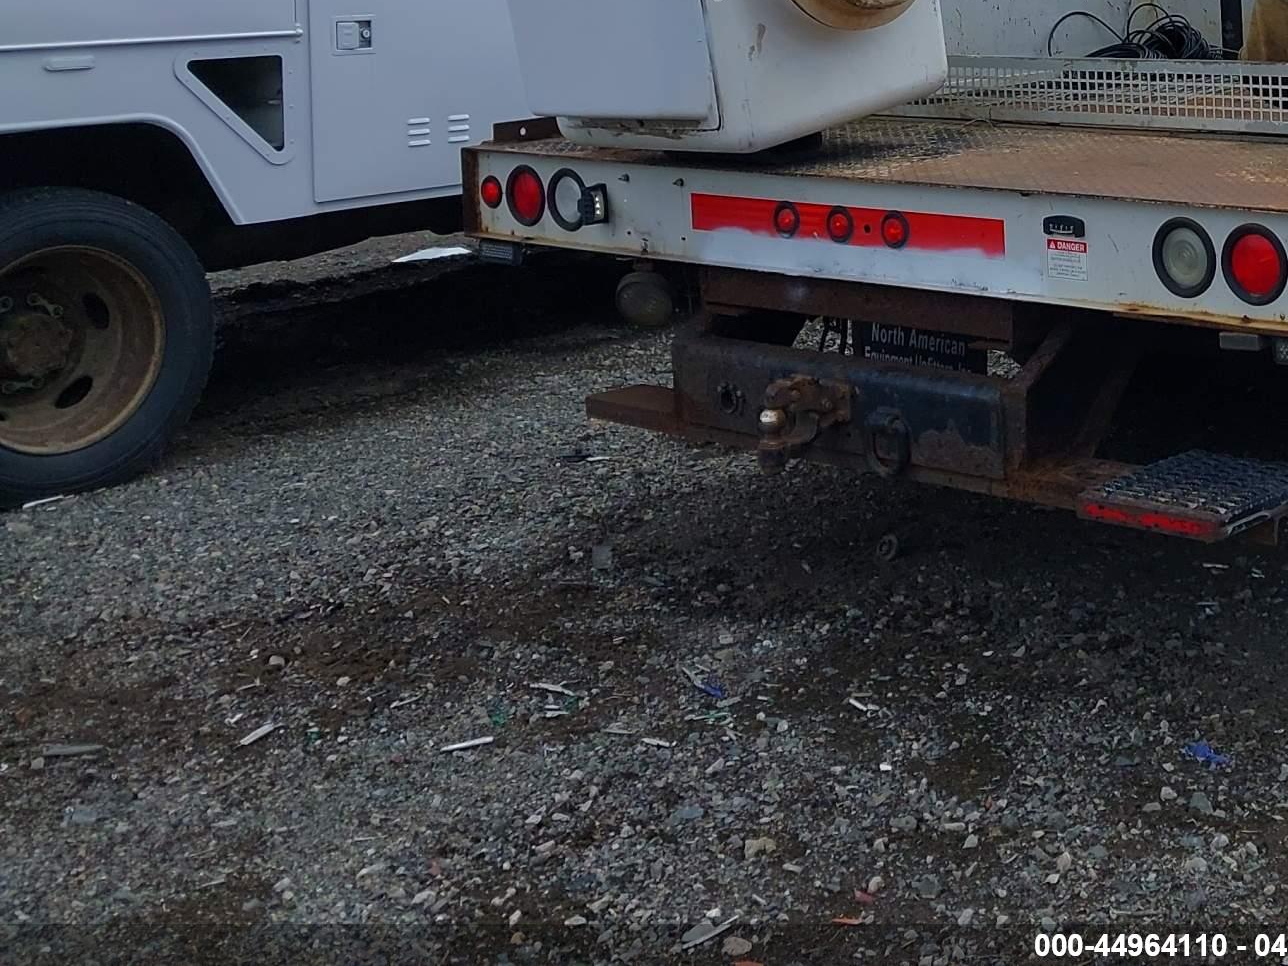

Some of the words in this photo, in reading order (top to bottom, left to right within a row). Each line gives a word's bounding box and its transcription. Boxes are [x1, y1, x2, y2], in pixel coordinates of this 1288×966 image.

[1056, 241, 1085, 252] DANGER
[871, 321, 905, 346] North
[908, 329, 966, 357] American
